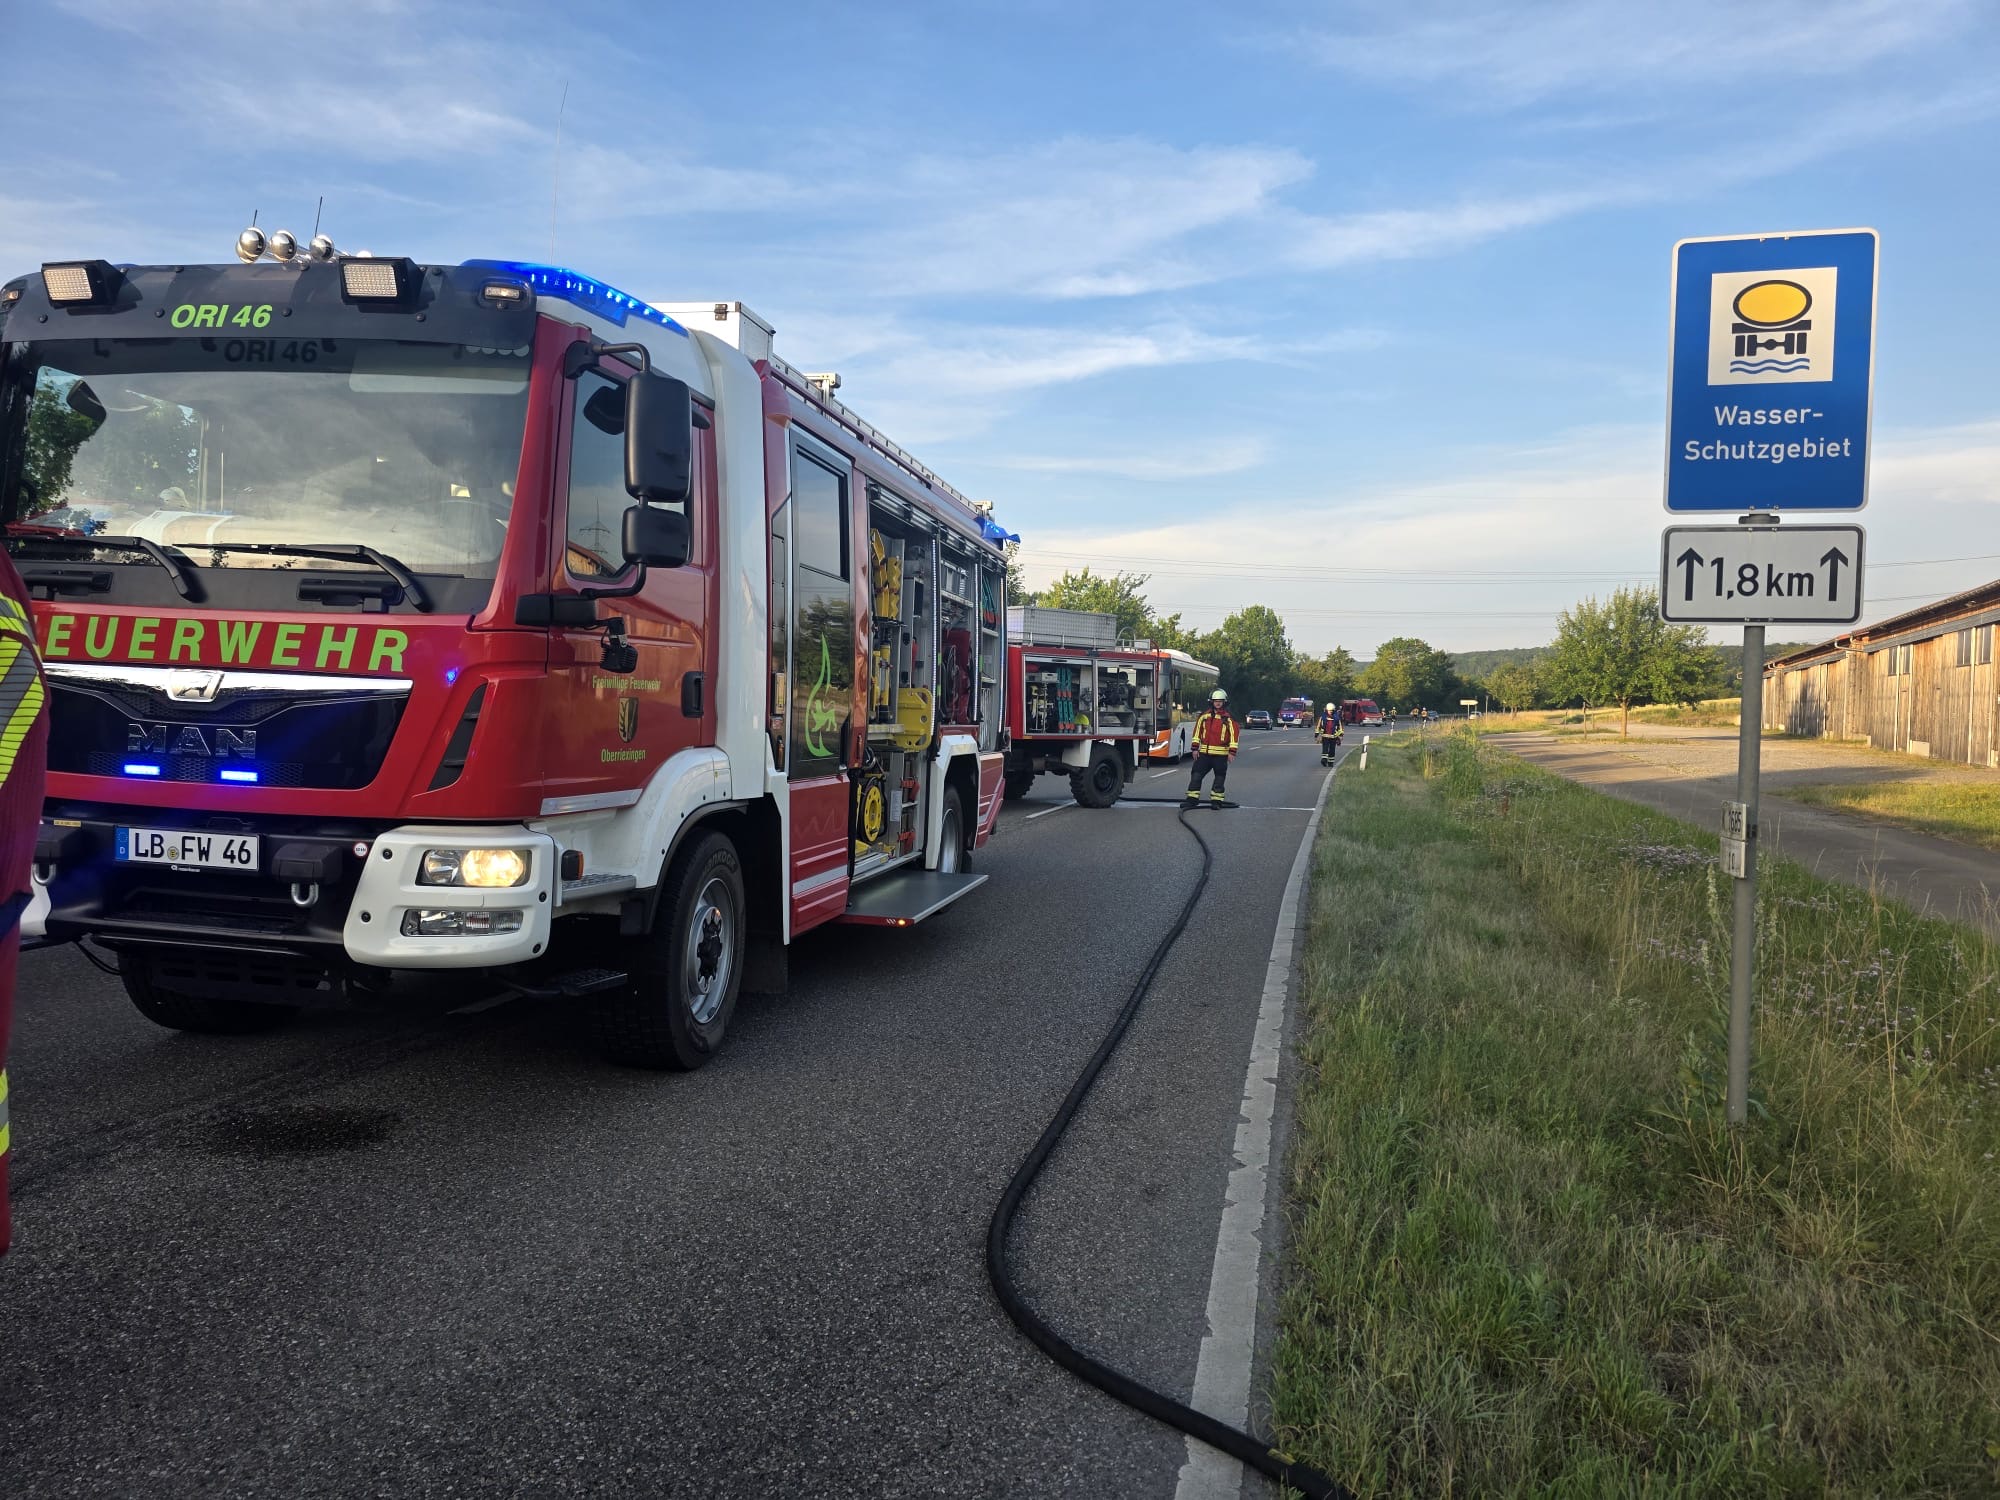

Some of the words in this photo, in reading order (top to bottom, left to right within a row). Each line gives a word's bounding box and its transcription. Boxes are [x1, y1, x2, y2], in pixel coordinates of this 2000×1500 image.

[170, 304, 230, 328] ORI
[231, 304, 273, 328] 46
[223, 339, 276, 363] ORI
[281, 340, 318, 363] 46
[1714, 405, 1824, 426] Wasser-
[1684, 437, 1851, 464] Schutzgebiet
[1710, 557, 1760, 600] 1,8
[1766, 563, 1814, 597] km
[33, 614, 409, 673] EUERWEHR
[592, 675, 628, 692] Freiwillige
[629, 676, 661, 690] Feuerwehr
[127, 723, 257, 759] MAN
[601, 748, 646, 763] Oberriexingen
[134, 832, 165, 859] LB
[180, 835, 212, 862] FW
[222, 839, 251, 864] 46
